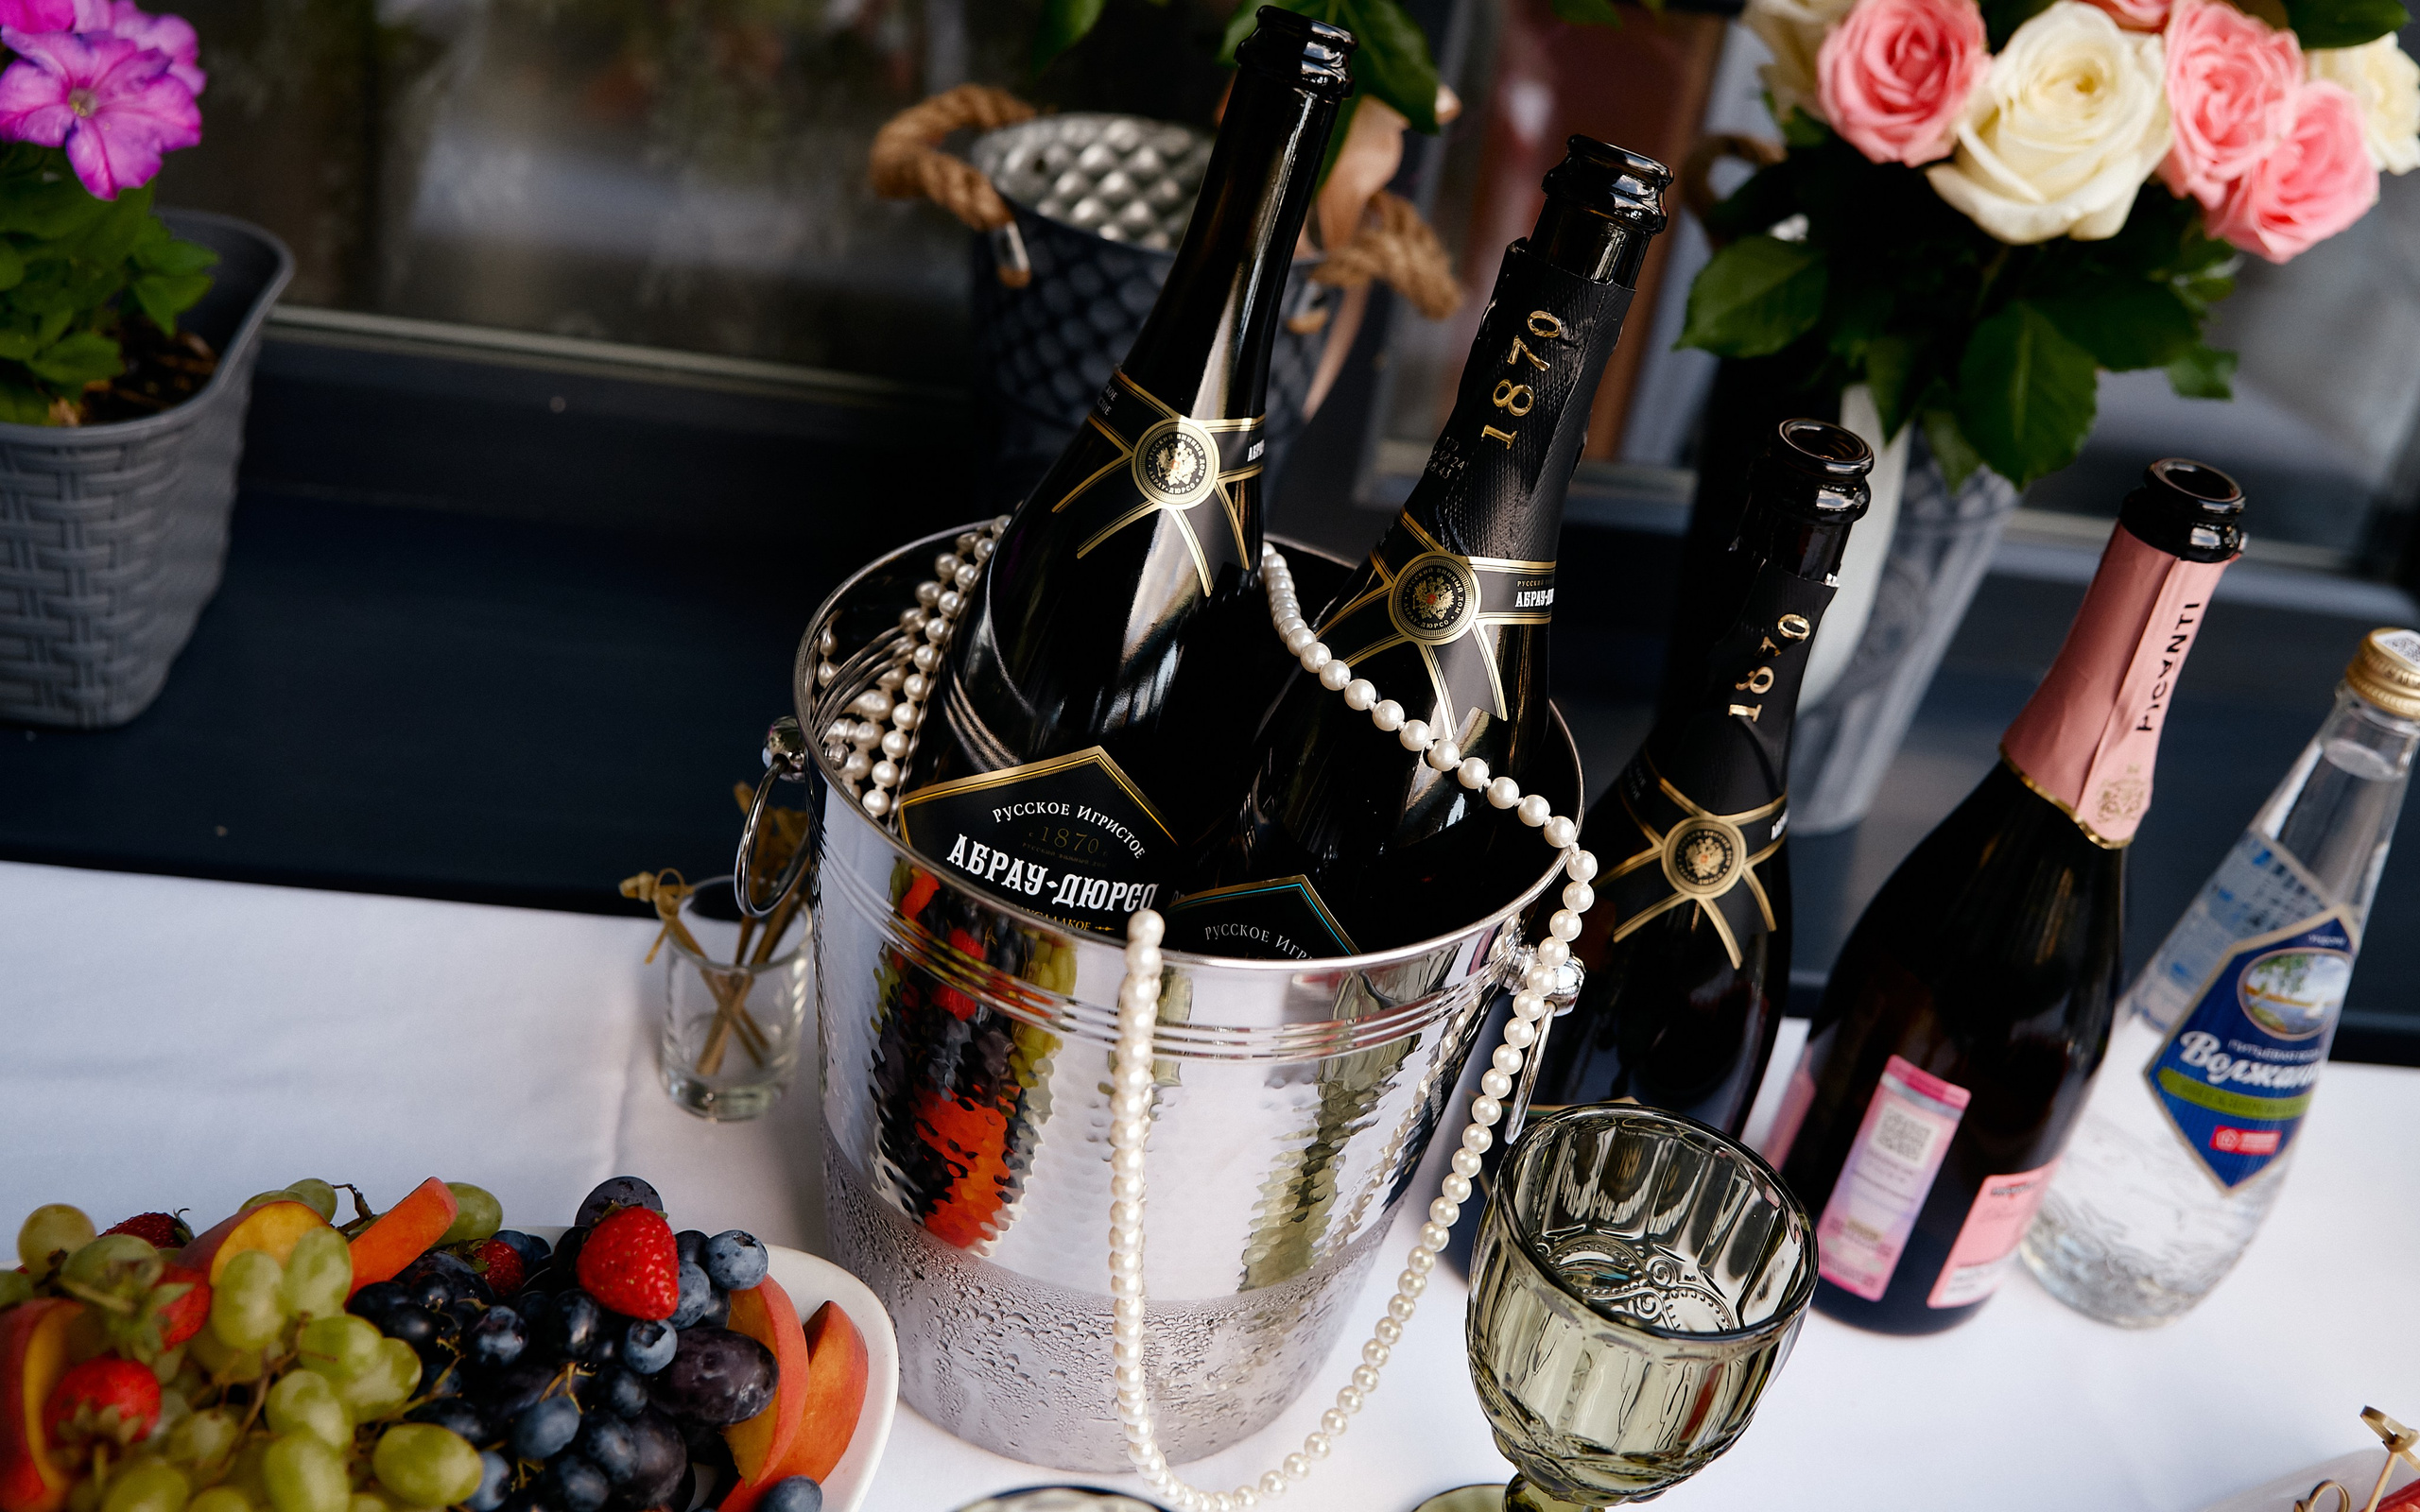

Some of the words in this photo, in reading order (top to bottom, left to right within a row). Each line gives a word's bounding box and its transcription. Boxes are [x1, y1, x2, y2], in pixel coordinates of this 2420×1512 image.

[1480, 309, 1562, 451] 1870
[993, 801, 1070, 823] РУССКОЕ
[1076, 804, 1146, 859] ИГРИСТОЕ
[1041, 825, 1099, 854] 1870
[946, 833, 1160, 913] АБРАУ-ДЮРСО
[1204, 922, 1270, 943] РУССКОЕ
